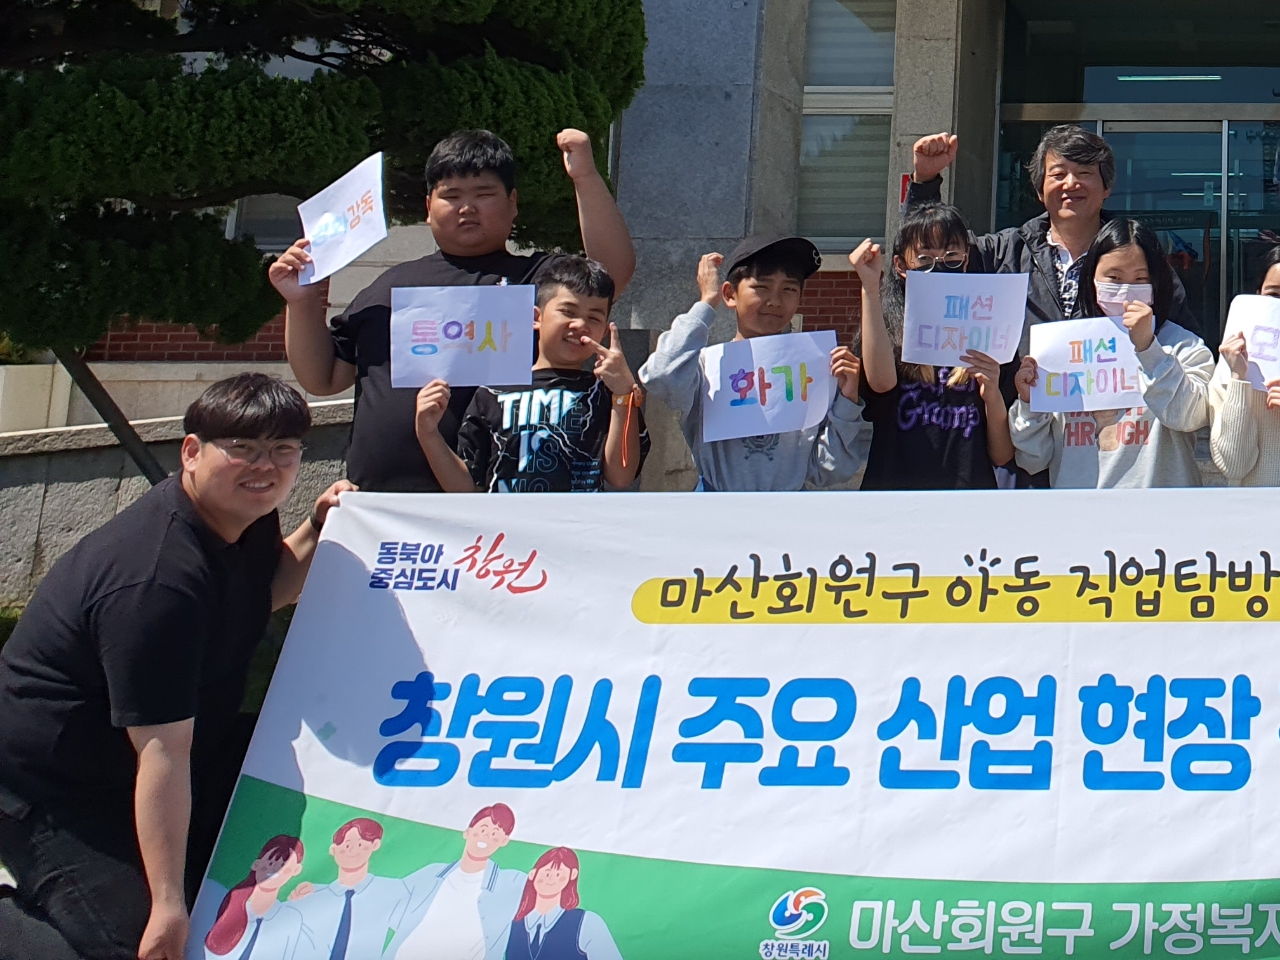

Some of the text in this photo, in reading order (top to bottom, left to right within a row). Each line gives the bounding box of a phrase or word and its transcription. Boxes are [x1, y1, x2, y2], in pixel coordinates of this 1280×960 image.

[943, 295, 994, 321] 패션
[411, 320, 513, 355] 통역사
[918, 324, 1011, 352] 디자이너
[1069, 337, 1118, 364] 패션
[729, 362, 813, 407] 화가
[1046, 367, 1140, 397] 디자이너
[376, 541, 445, 565] 동북아
[453, 532, 548, 595] 창원
[368, 567, 460, 591] 중심도시
[660, 551, 929, 620] 마산회원구
[945, 547, 1051, 618] 아동
[373, 671, 662, 788] 창원시
[672, 676, 857, 789] 주요
[878, 674, 1057, 790] 산업
[1078, 673, 1261, 791] 현장
[848, 899, 1094, 956] 마산회원구
[761, 942, 827, 958] 창원특례시
